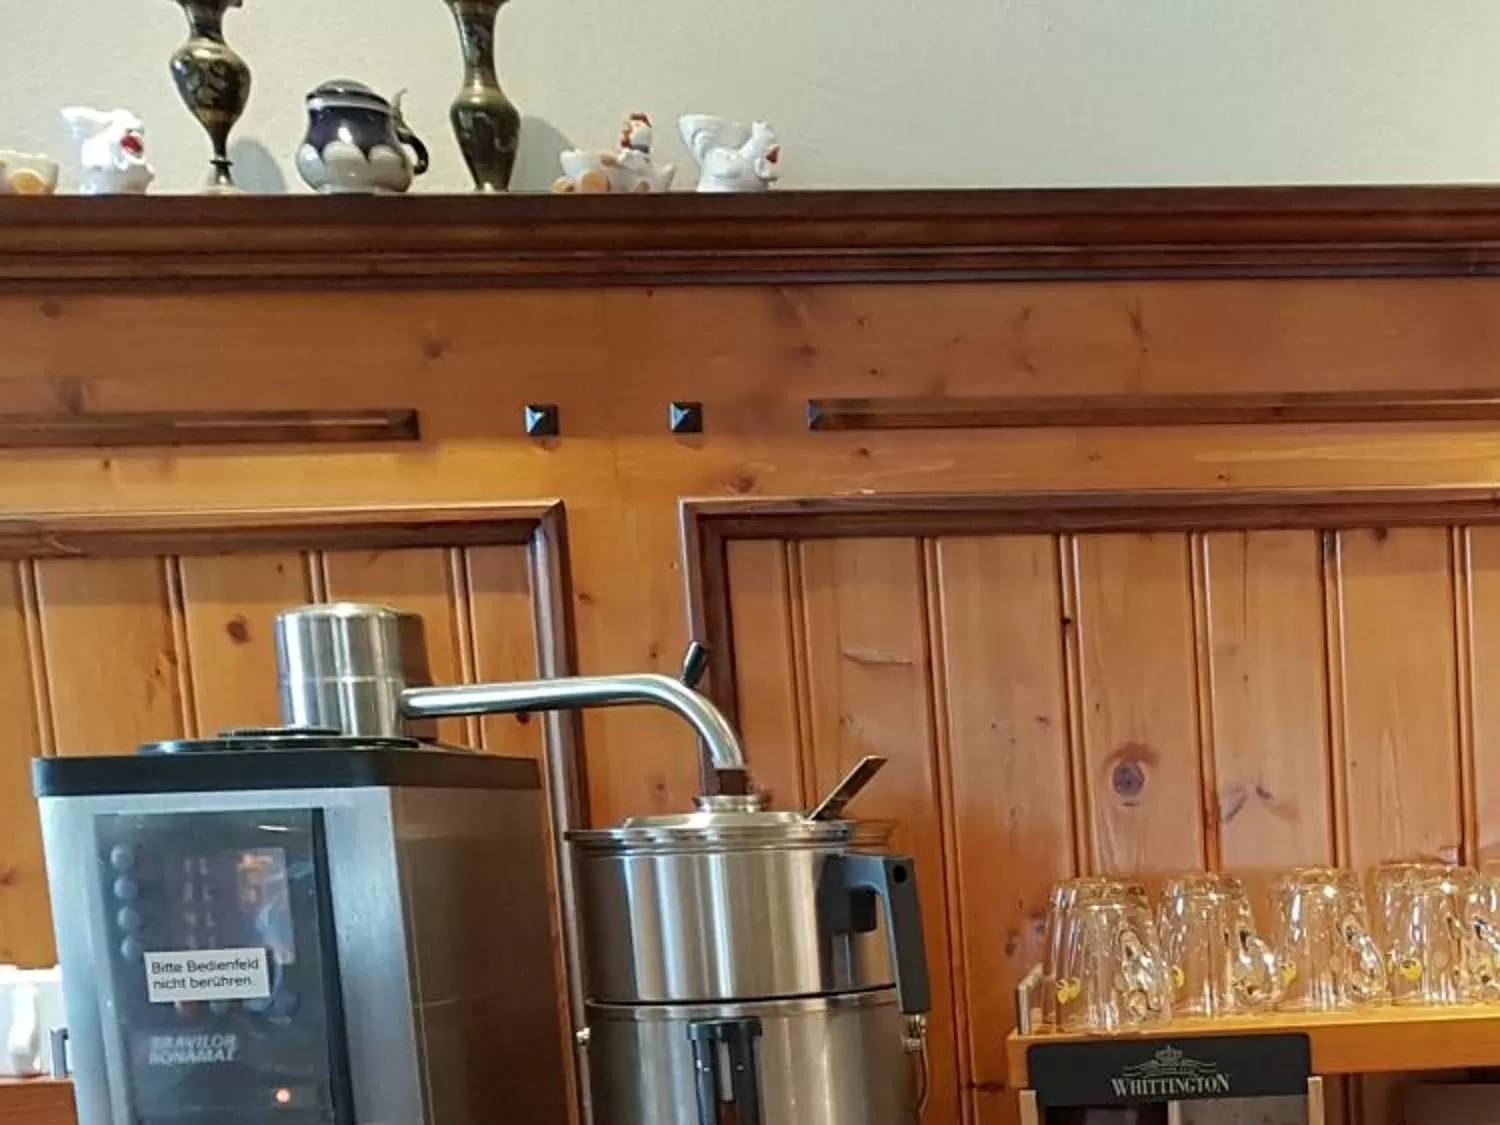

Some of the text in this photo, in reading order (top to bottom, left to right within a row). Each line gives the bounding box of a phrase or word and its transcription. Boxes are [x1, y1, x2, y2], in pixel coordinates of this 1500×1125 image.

[151, 957, 259, 975] Bitte Bedienfeld
[153, 976, 187, 990] nicht
[1110, 1073, 1230, 1097] WHITTINGTON
